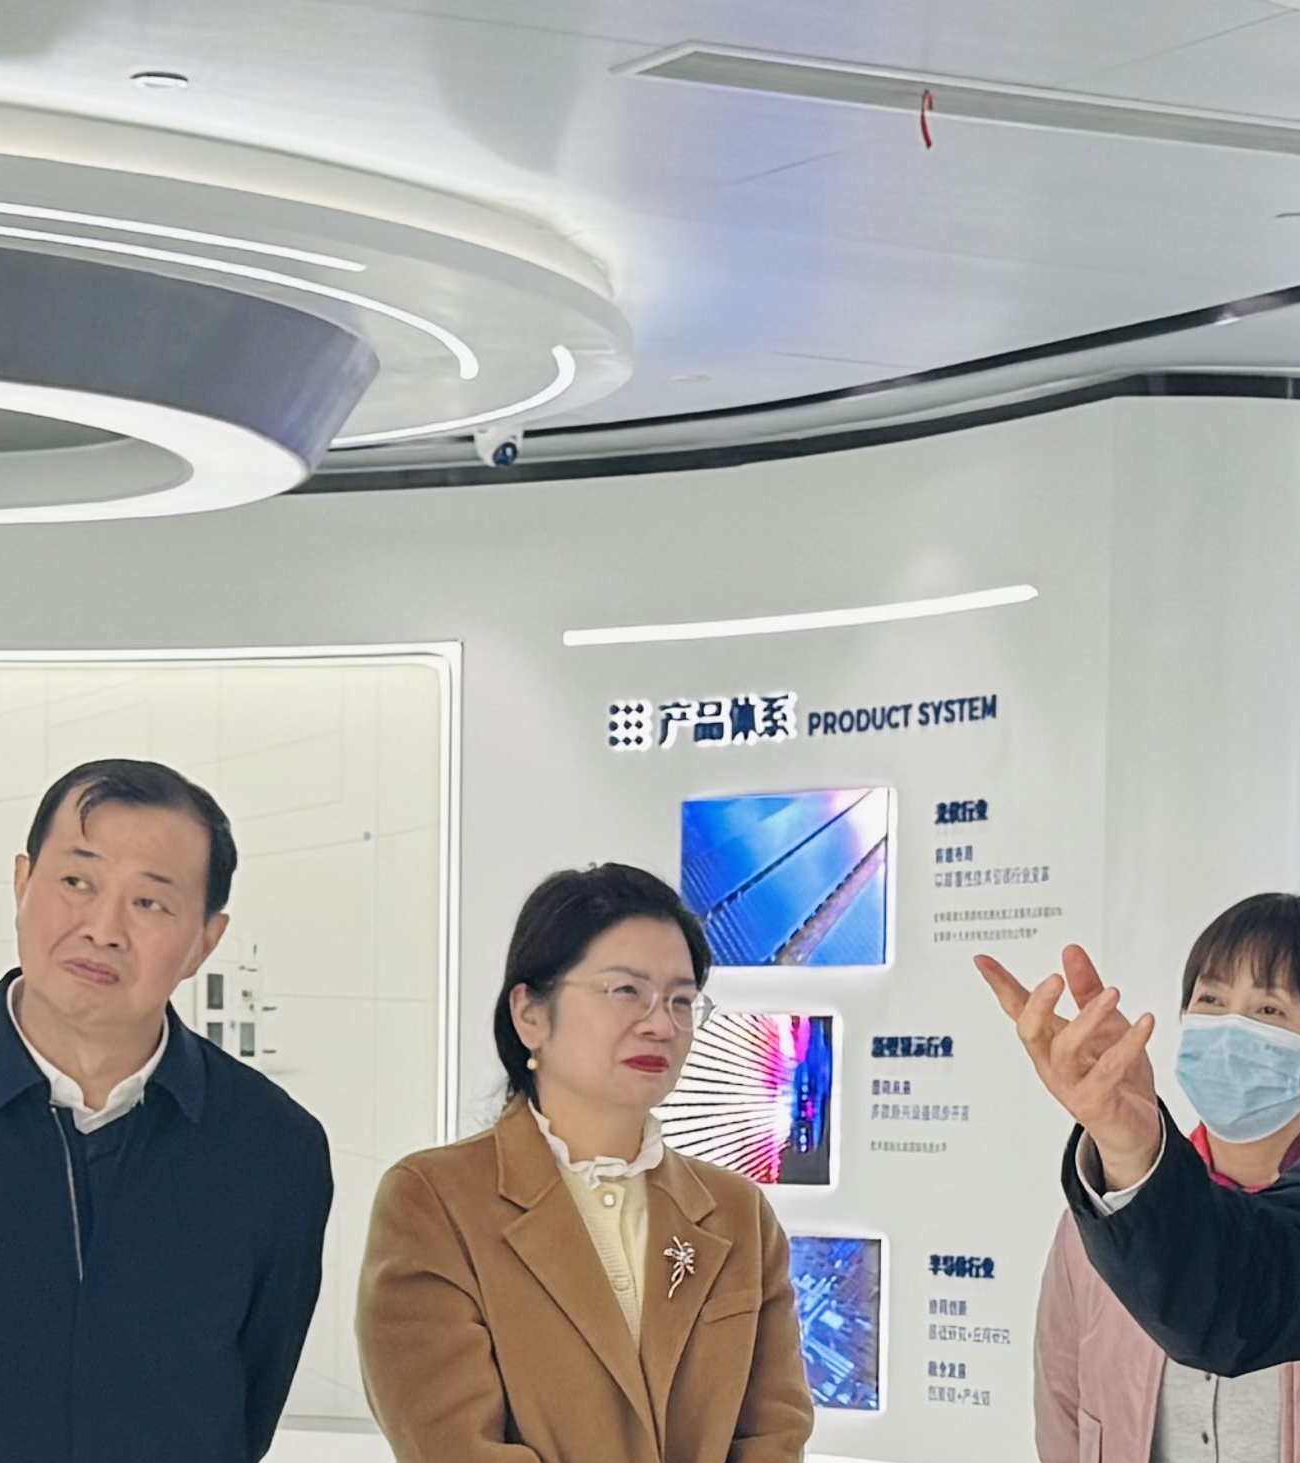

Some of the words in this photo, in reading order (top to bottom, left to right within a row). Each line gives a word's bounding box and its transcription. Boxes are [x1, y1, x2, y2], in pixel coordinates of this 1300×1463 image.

[658, 693, 789, 747] 产品体系
[807, 703, 912, 737] PRODUCT
[917, 693, 998, 727] SYSTEM
[928, 1253, 996, 1280] 半导体行业
